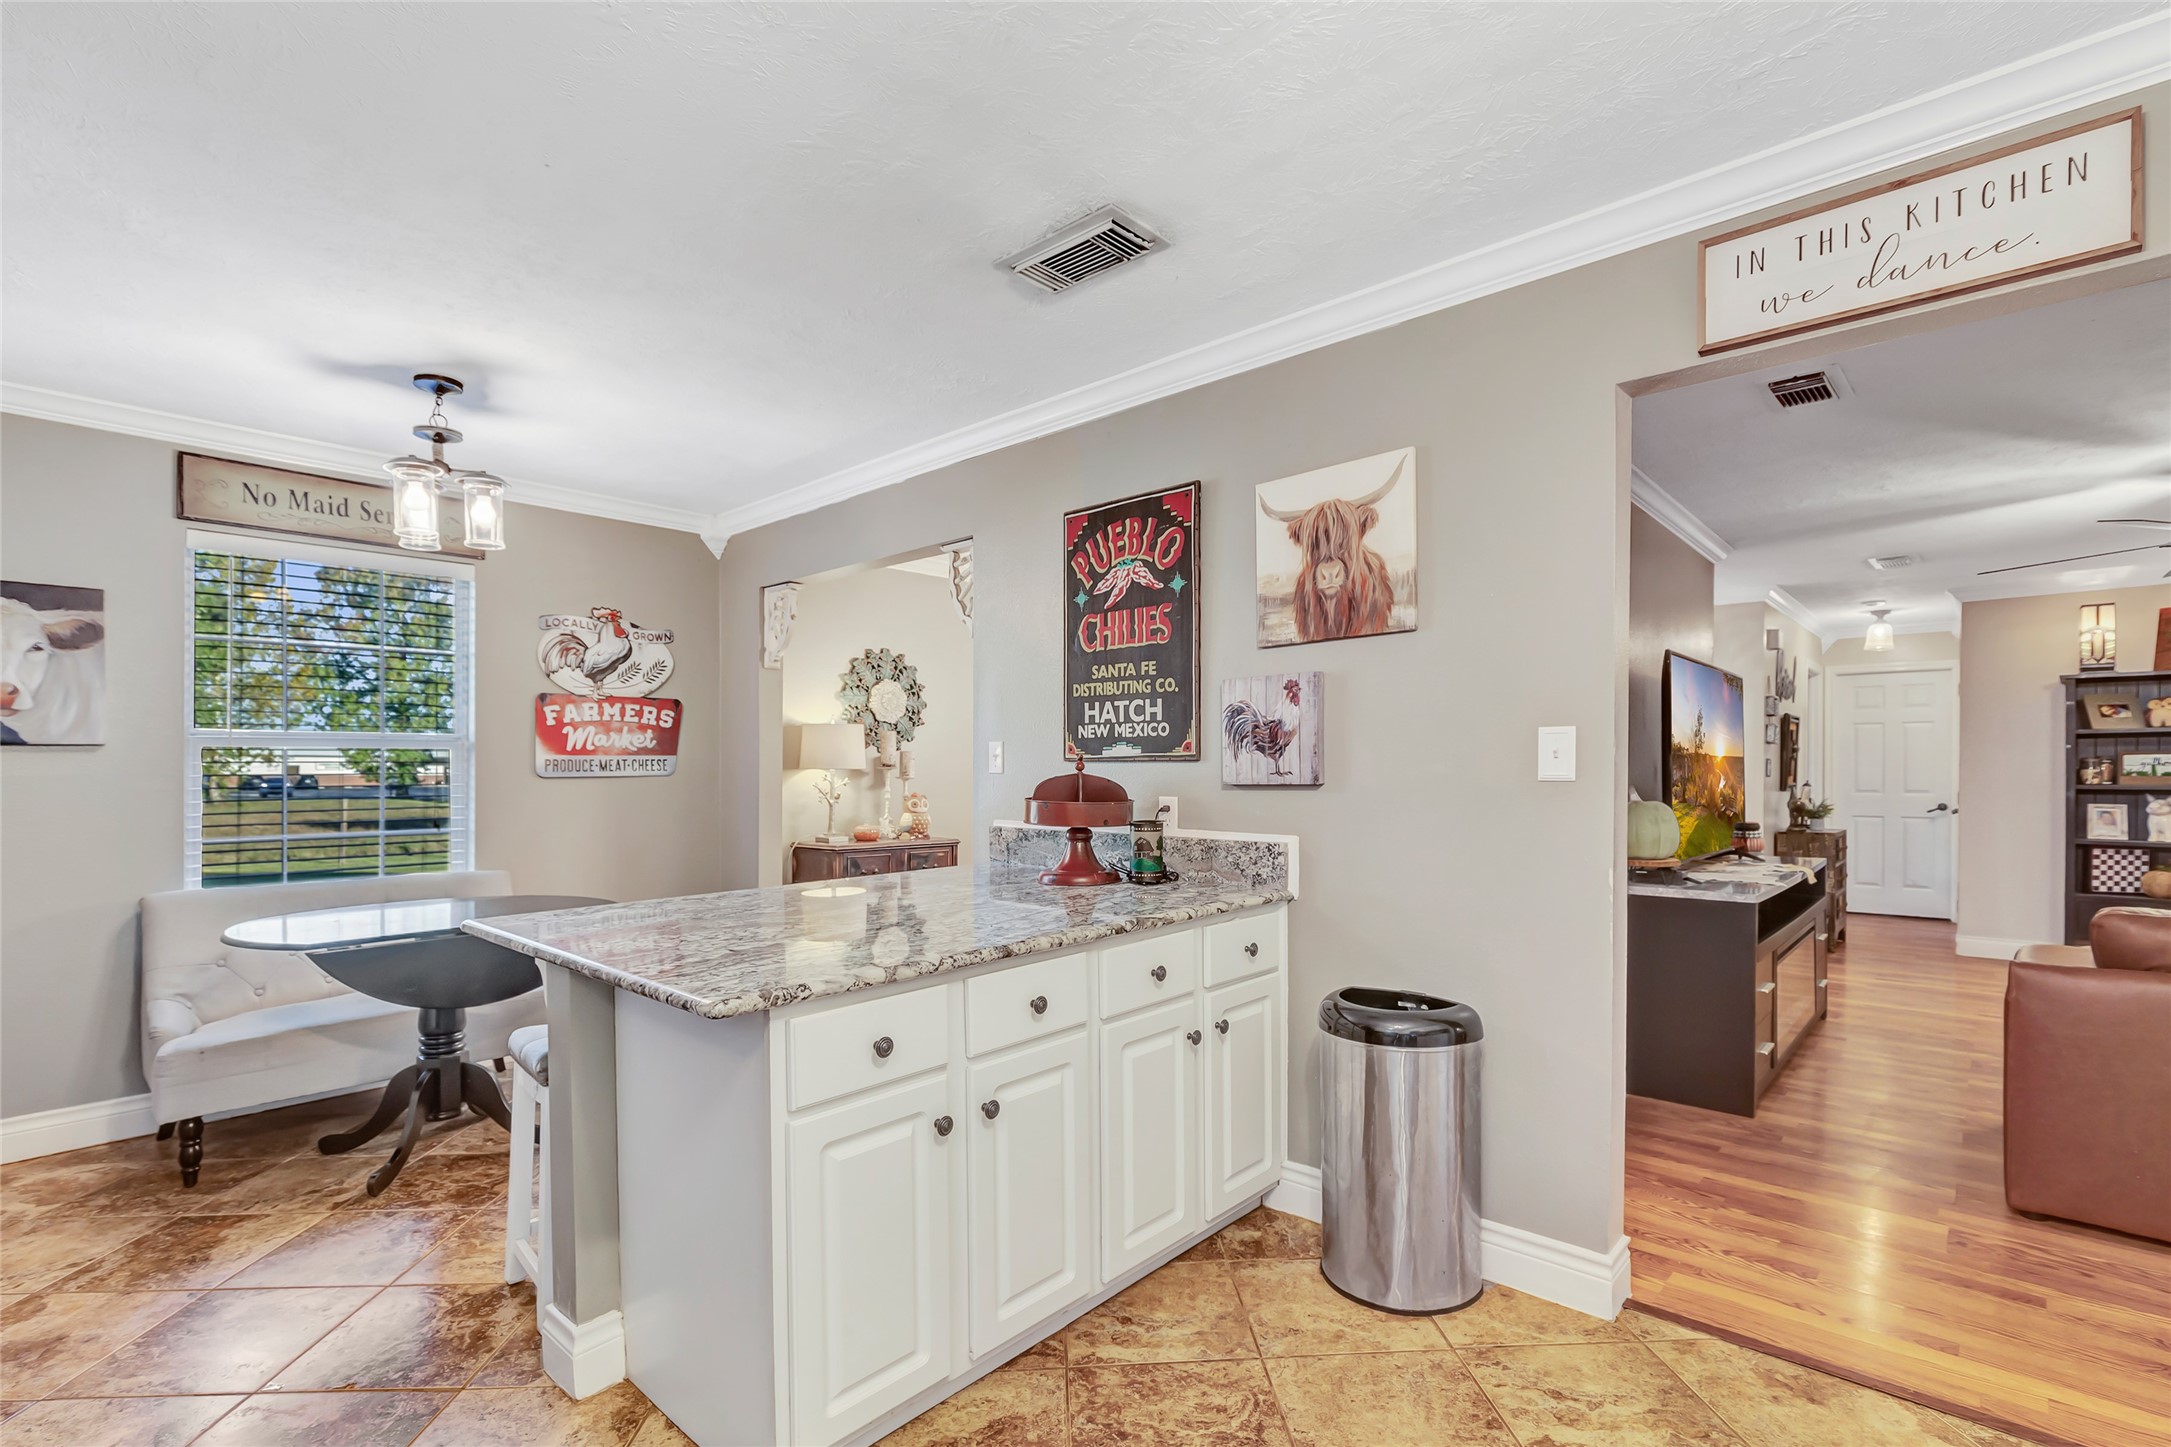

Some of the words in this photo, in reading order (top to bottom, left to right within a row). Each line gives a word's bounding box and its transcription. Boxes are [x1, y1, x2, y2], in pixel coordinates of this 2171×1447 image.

[1735, 247, 1766, 279] IN
[1795, 216, 1872, 262] THIS
[1906, 152, 2090, 232] KITCHEN
[1760, 284, 1834, 315] we
[1857, 232, 2041, 290] dance.
[241, 482, 277, 507] No
[288, 488, 350, 518] Maid
[1071, 516, 1186, 590] PUEBLO
[545, 617, 599, 631] LOCALLY
[632, 631, 672, 642] GROWN
[1078, 602, 1173, 652] CHILIES
[1091, 662, 1137, 679] SANTA
[1141, 660, 1157, 675] FE
[1072, 679, 1152, 697] DISTRIBUTING
[1155, 677, 1179, 693] CO.
[543, 702, 676, 729] FARMERS
[1084, 698, 1163, 724] HATCH
[562, 725, 657, 752] Market
[1078, 723, 1111, 739] NEW
[1114, 721, 1170, 738] MEXICO
